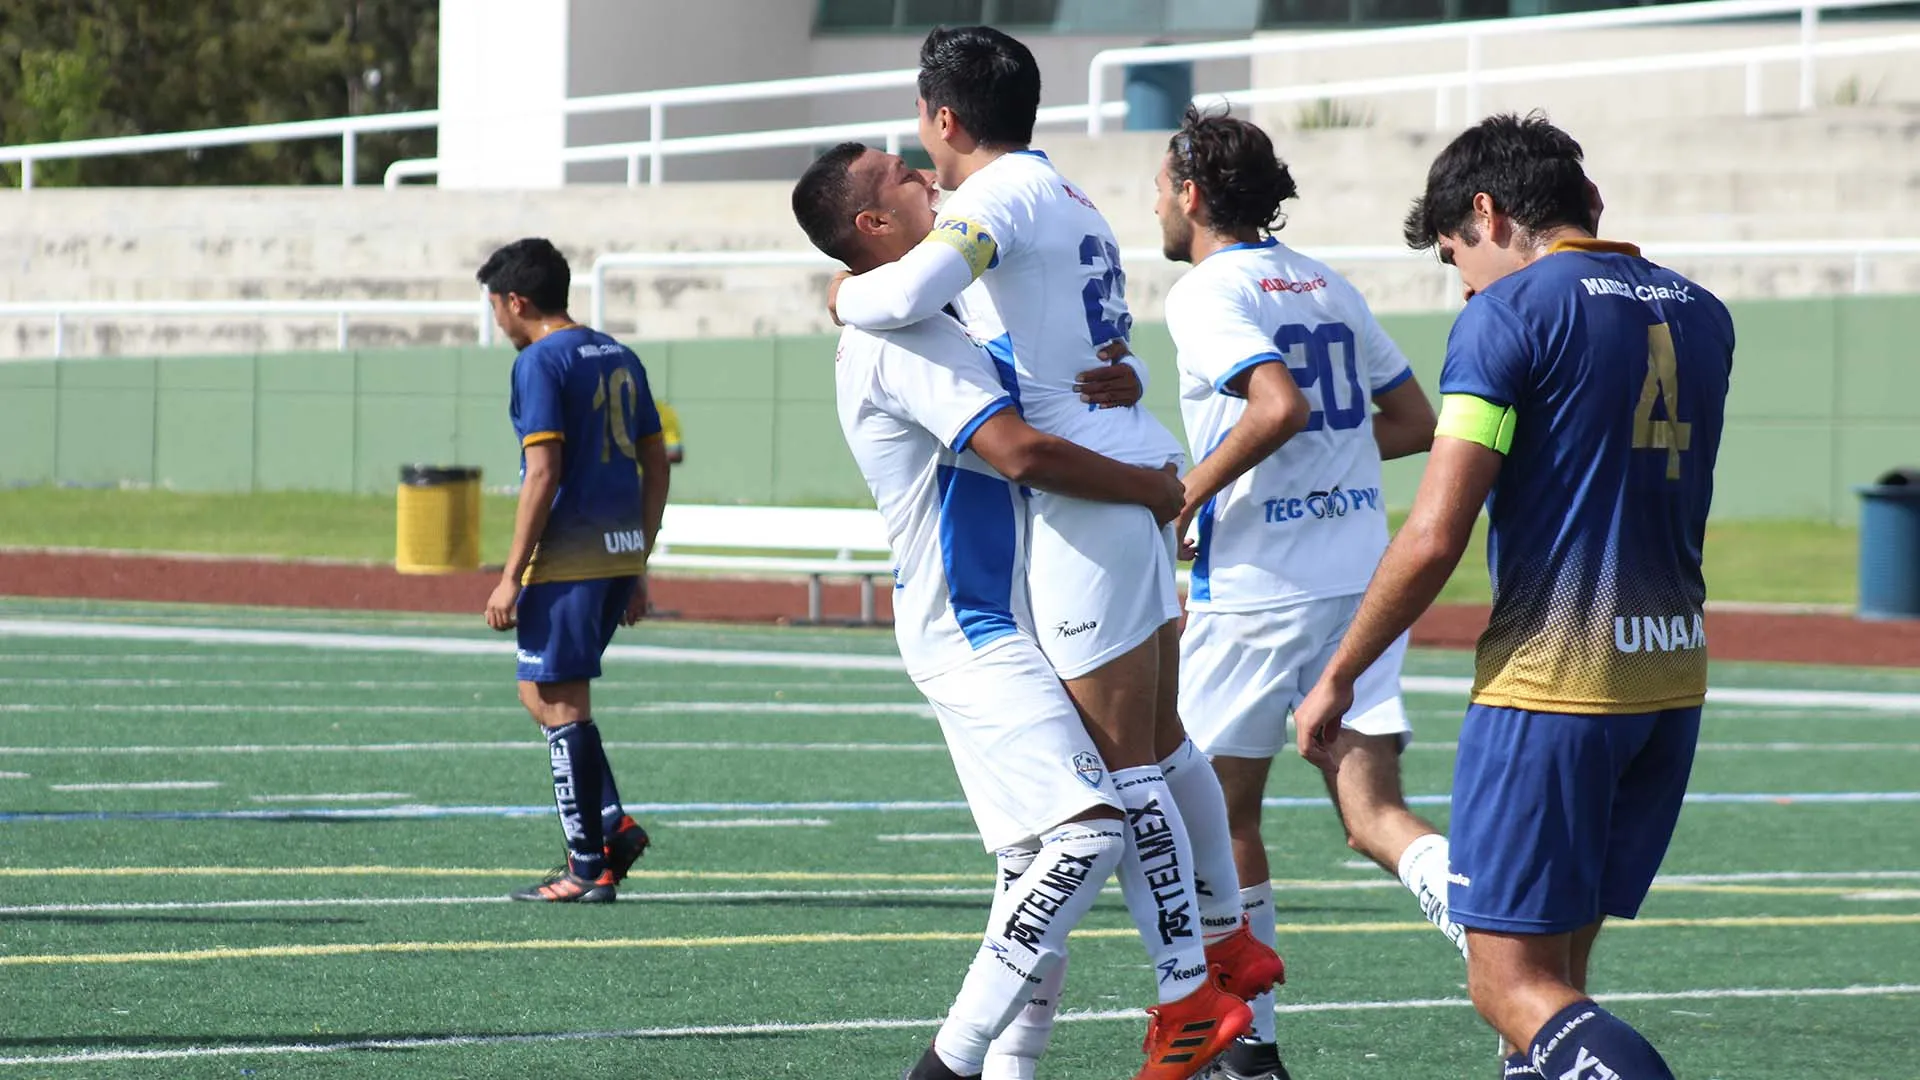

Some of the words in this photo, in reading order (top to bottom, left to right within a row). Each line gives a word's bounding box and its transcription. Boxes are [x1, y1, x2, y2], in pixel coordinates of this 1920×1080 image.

[1635, 282, 1690, 303] Claro
[1273, 322, 1366, 433] 20
[1631, 321, 1692, 480] 4
[592, 367, 637, 464] 10
[1263, 497, 1304, 523] TEC
[603, 529, 645, 554] UNA
[1063, 620, 1098, 638] Keuka
[1125, 798, 1185, 909] TELMEX
[1016, 852, 1099, 926] TELMEX
[995, 952, 1042, 985] Keuka
[1538, 1011, 1596, 1065] Keuka
